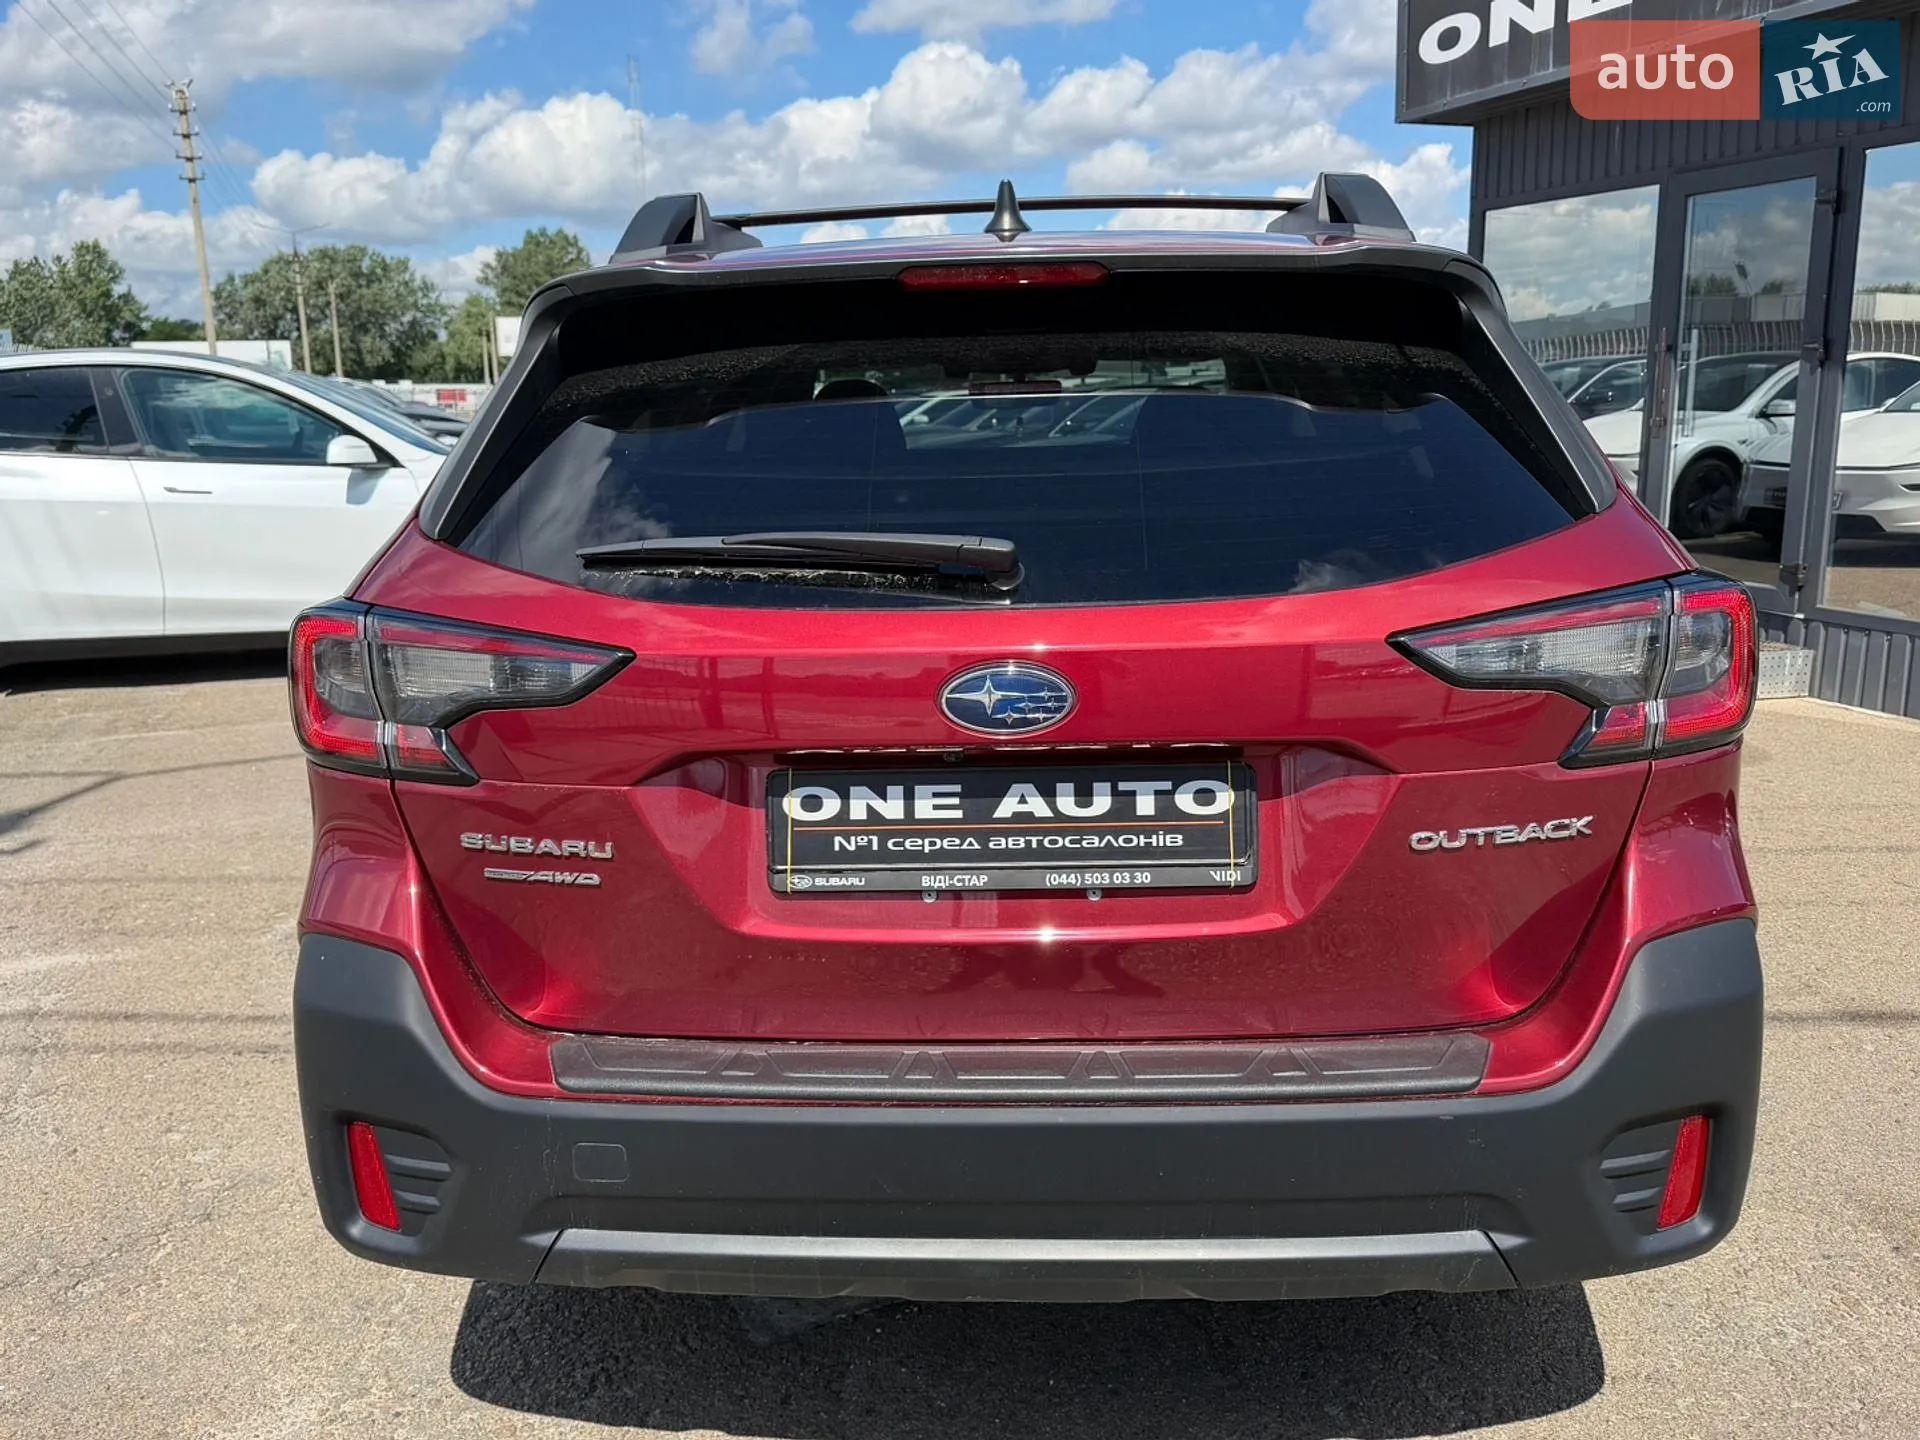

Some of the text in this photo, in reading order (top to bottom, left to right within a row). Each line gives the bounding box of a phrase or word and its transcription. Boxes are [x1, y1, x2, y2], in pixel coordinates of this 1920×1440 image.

[782, 779, 1235, 822] ONE AUTO
[887, 837, 981, 853] серед
[988, 831, 1184, 848] автосалонів
[1409, 815, 1594, 851] OUTBACK
[460, 832, 614, 859] SUBARU
[526, 870, 601, 885] AWD
[814, 877, 866, 886] SUBARU
[921, 875, 988, 888] ВІДІ-СТАР
[1045, 871, 1151, 886] (044) 503 03 30
